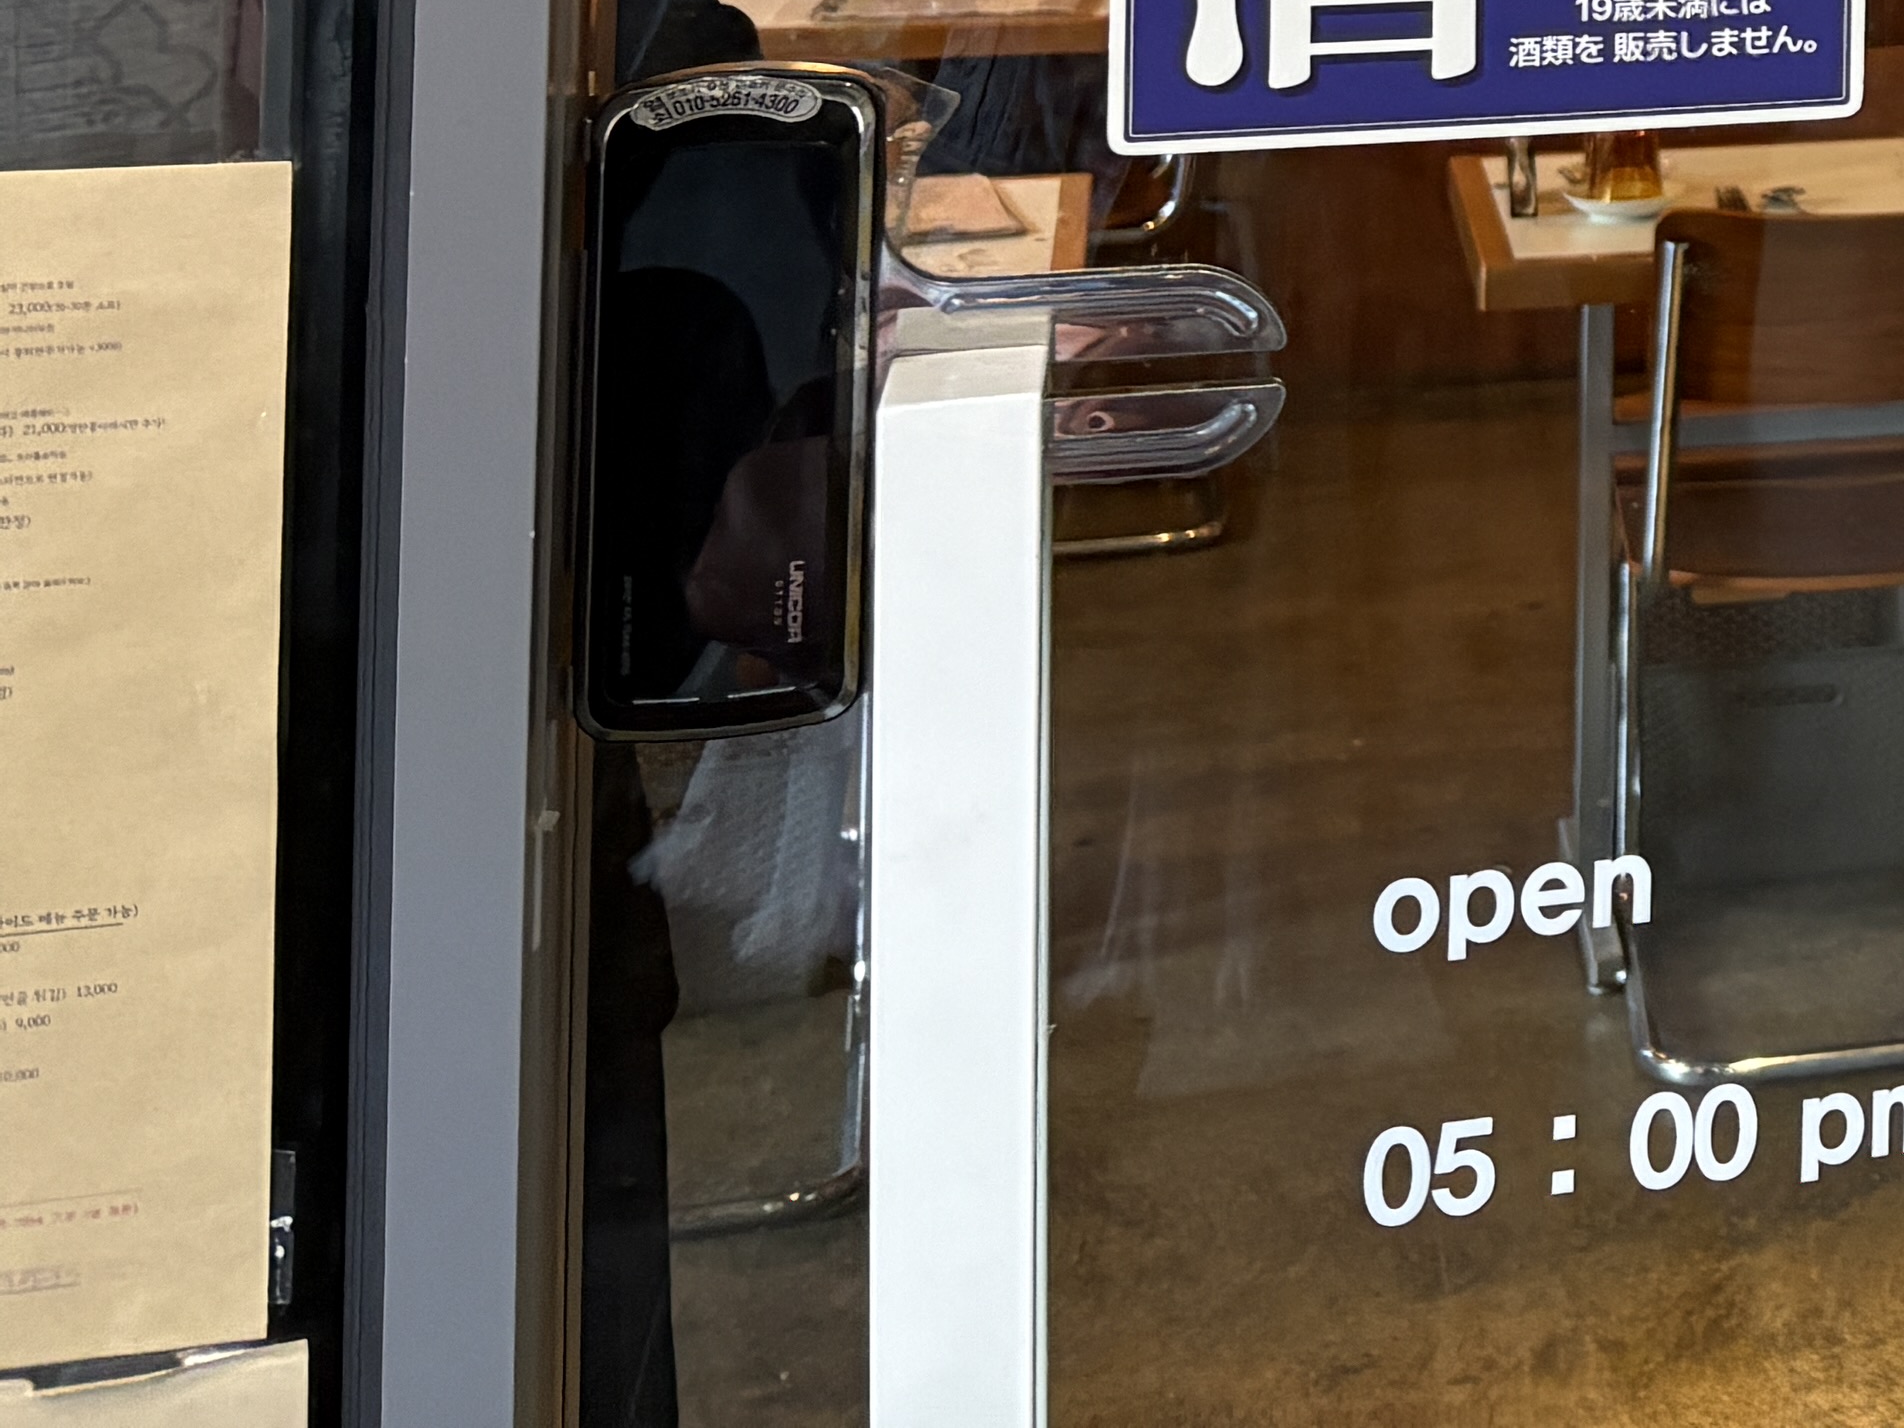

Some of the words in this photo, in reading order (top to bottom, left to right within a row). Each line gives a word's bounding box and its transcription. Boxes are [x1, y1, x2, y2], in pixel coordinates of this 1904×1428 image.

[1508, 35, 1605, 69] 酒類を
[1612, 24, 1819, 64] 販売しません。
[1372, 854, 1652, 962] open
[1363, 1116, 1496, 1228] 05
[1629, 1083, 1758, 1191] 00
